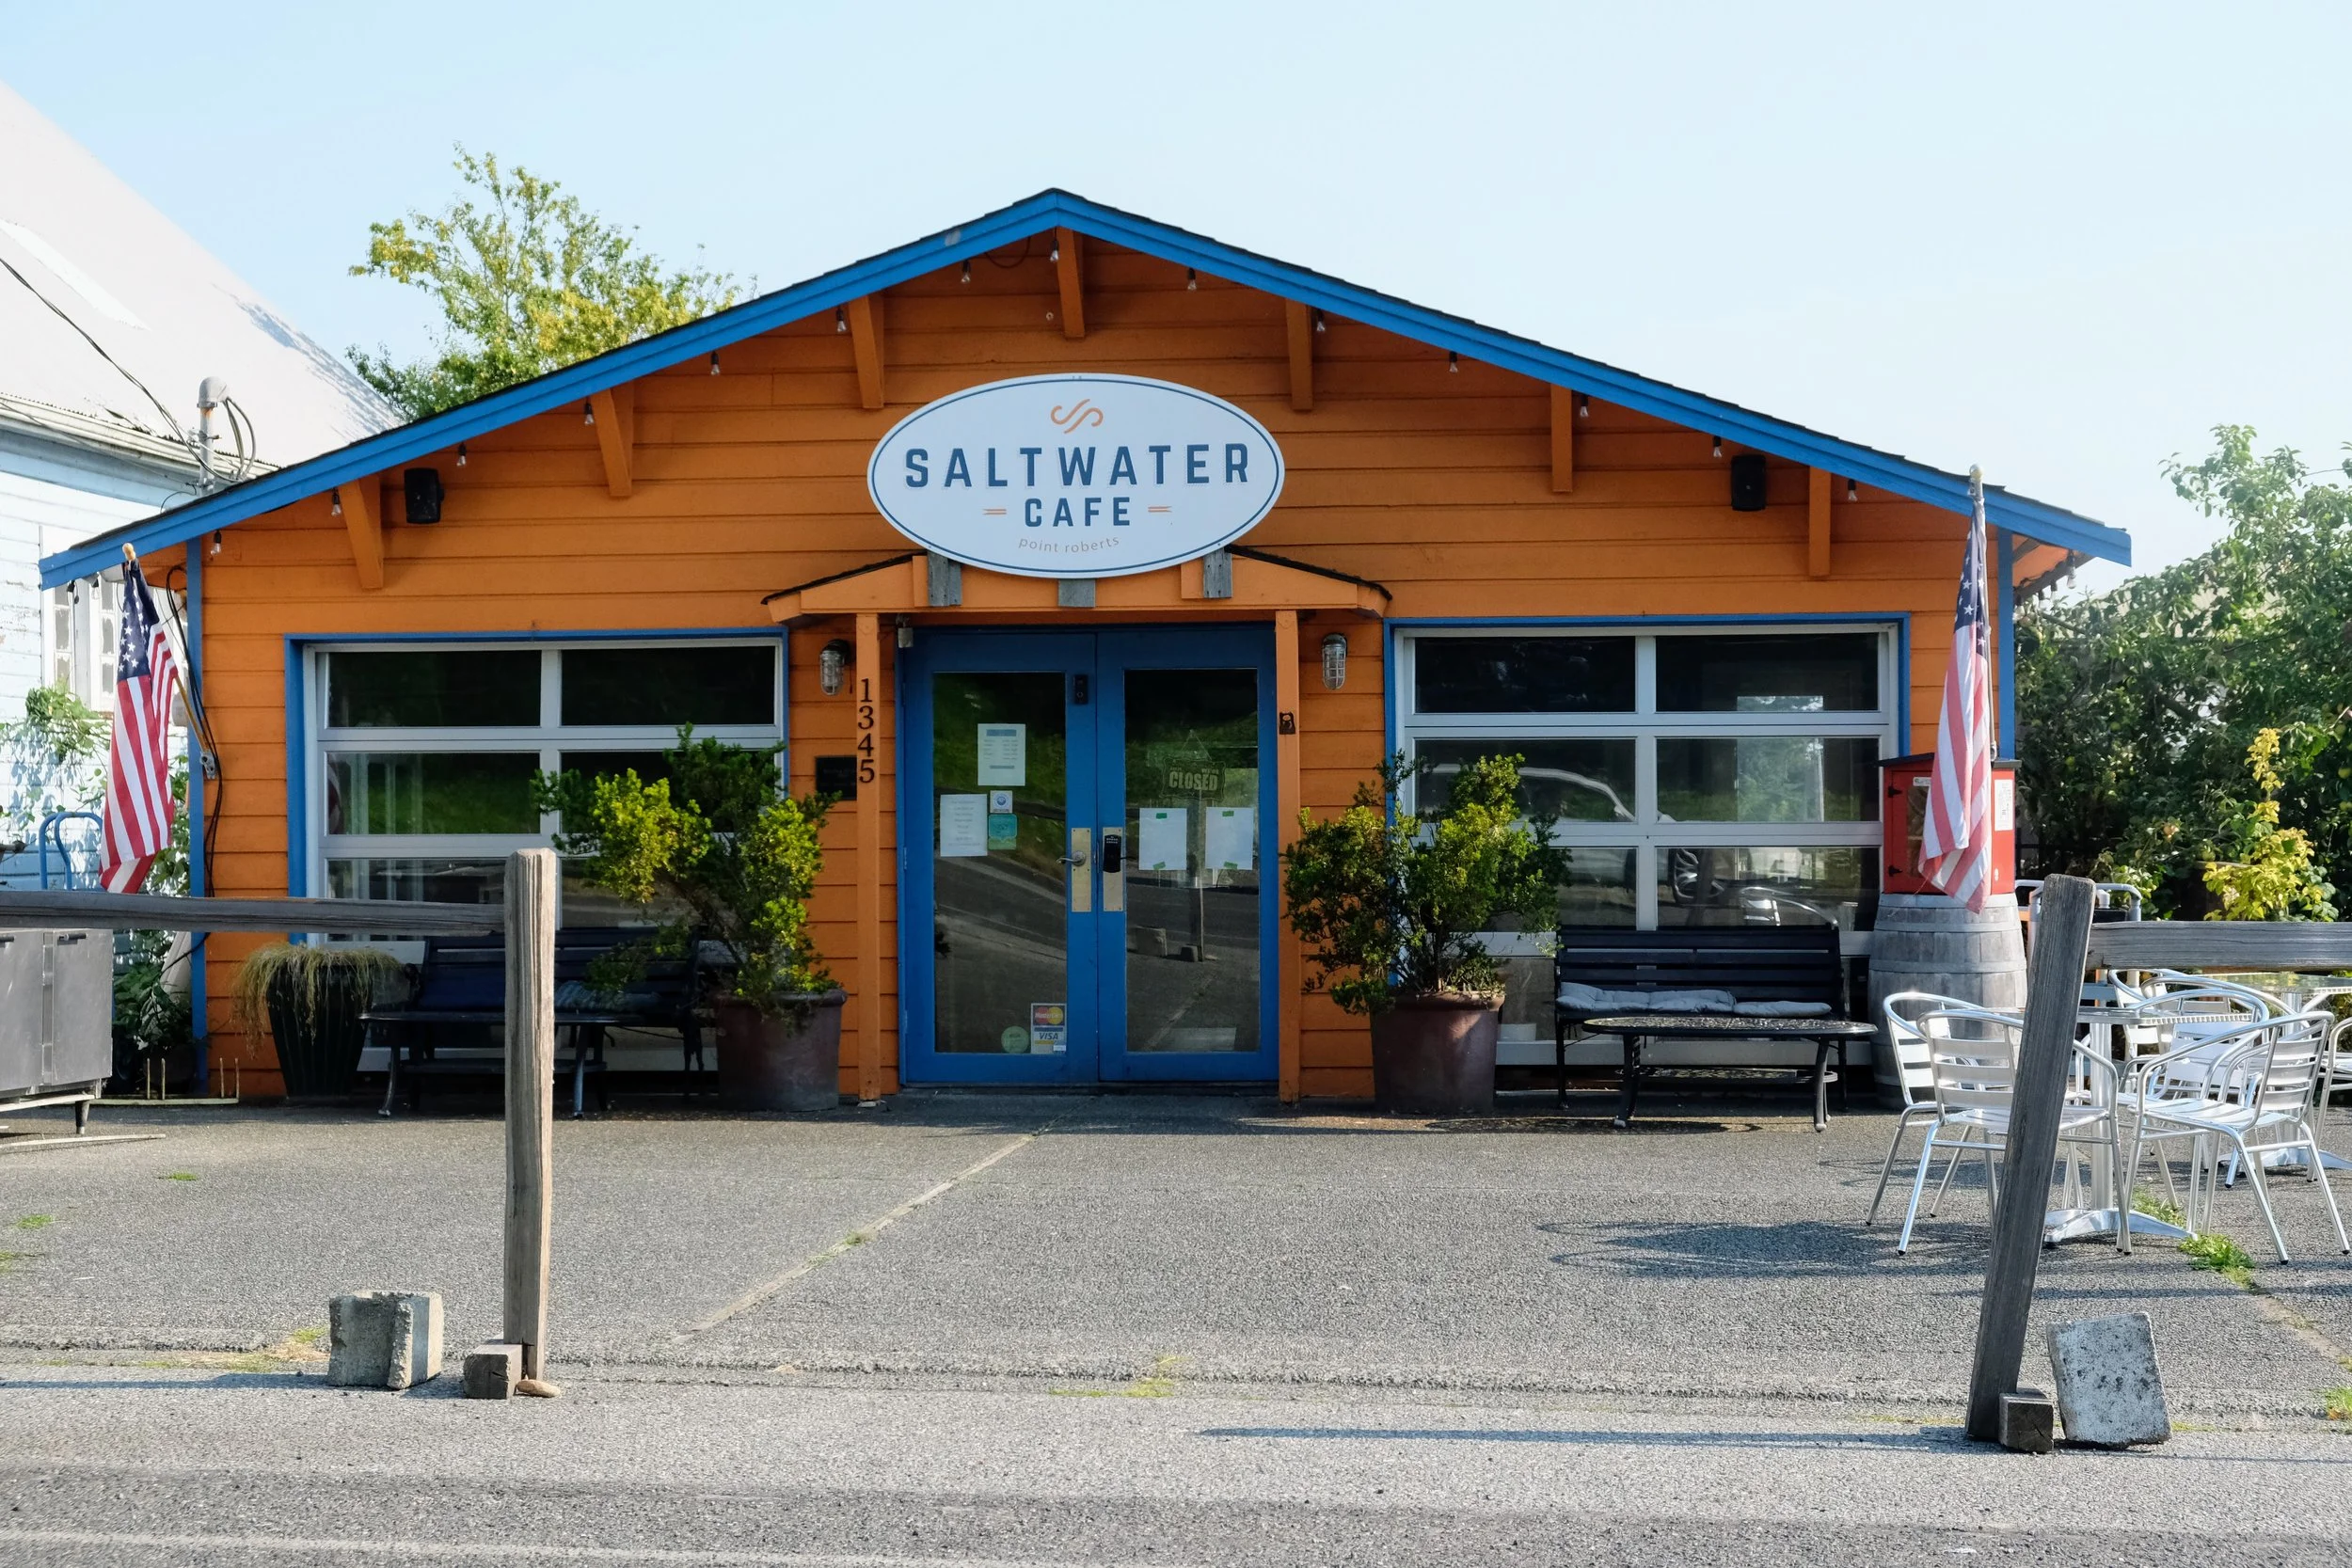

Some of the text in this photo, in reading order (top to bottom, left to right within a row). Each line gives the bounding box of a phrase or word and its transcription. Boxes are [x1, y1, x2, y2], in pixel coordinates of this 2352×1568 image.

[906, 443, 1248, 487] SALTWATER
[1025, 497, 1130, 527] CAFE
[1019, 536, 1120, 553] point roberts
[858, 678, 875, 783] 1345
[1169, 771, 1218, 790] CLOSED
